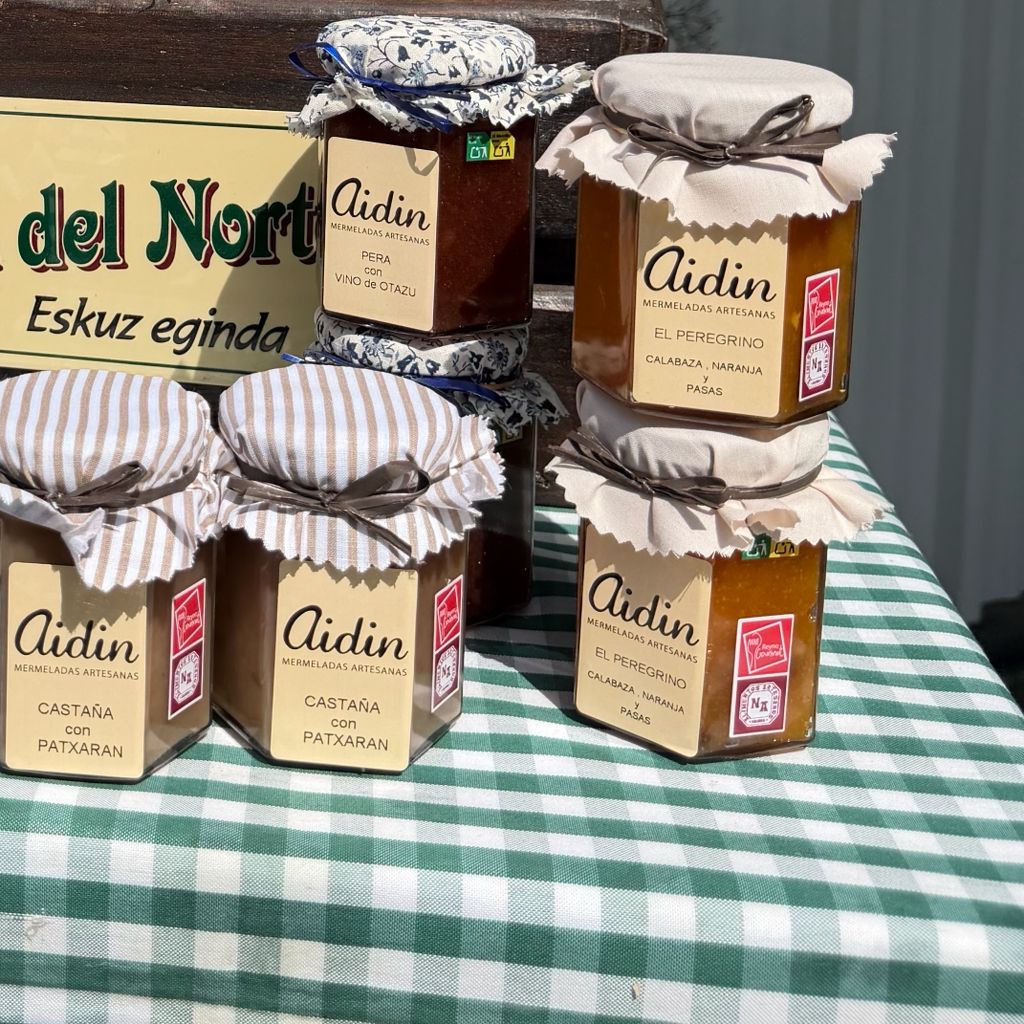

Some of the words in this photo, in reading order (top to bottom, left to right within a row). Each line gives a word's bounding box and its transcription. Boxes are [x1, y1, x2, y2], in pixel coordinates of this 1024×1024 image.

[331, 177, 431, 232] Aidin
[17, 183, 130, 270] del
[145, 177, 322, 271] Nort
[330, 222, 383, 238] MERMELADAS
[385, 231, 431, 246] ARTESANAS
[361, 250, 391, 265] PERA
[364, 267, 383, 277] con
[643, 245, 777, 303] Aidin
[335, 273, 362, 287] VINO
[364, 278, 377, 289] de
[379, 279, 417, 298] OTAZU
[642, 299, 713, 313] MERMELADAS
[716, 306, 776, 320] ARTESANAS
[27, 294, 145, 341] Eskuz
[150, 311, 292, 356] eginda
[654, 327, 672, 340] EL
[676, 329, 765, 350] PEREGRINO
[645, 354, 703, 369] CALABAZA
[711, 361, 764, 376] NARANJA
[686, 384, 724, 397] PASAS
[588, 572, 700, 646] Aidin
[14, 608, 140, 664] Aidin
[283, 605, 409, 661] Aidin
[587, 617, 645, 644] MERMELADAS
[647, 639, 699, 664] ARTESANAS
[14, 663, 80, 676] MERMELADAS
[83, 669, 140, 681] ARTESANAS
[281, 657, 348, 671] MERMELADAS
[351, 665, 408, 677] ARTESANAS
[595, 647, 610, 661] EL
[613, 653, 687, 690] PEREGRINO
[587, 670, 635, 695] CALABAZA
[642, 690, 685, 714] NARANJA
[38, 702, 114, 721] CASTAÑA
[304, 695, 381, 714] CASTAÑA
[620, 706, 651, 725] PASAS
[65, 725, 91, 737] con
[331, 718, 357, 730] con
[38, 739, 124, 758] PATXARAN
[303, 731, 389, 751] PATXARAN
